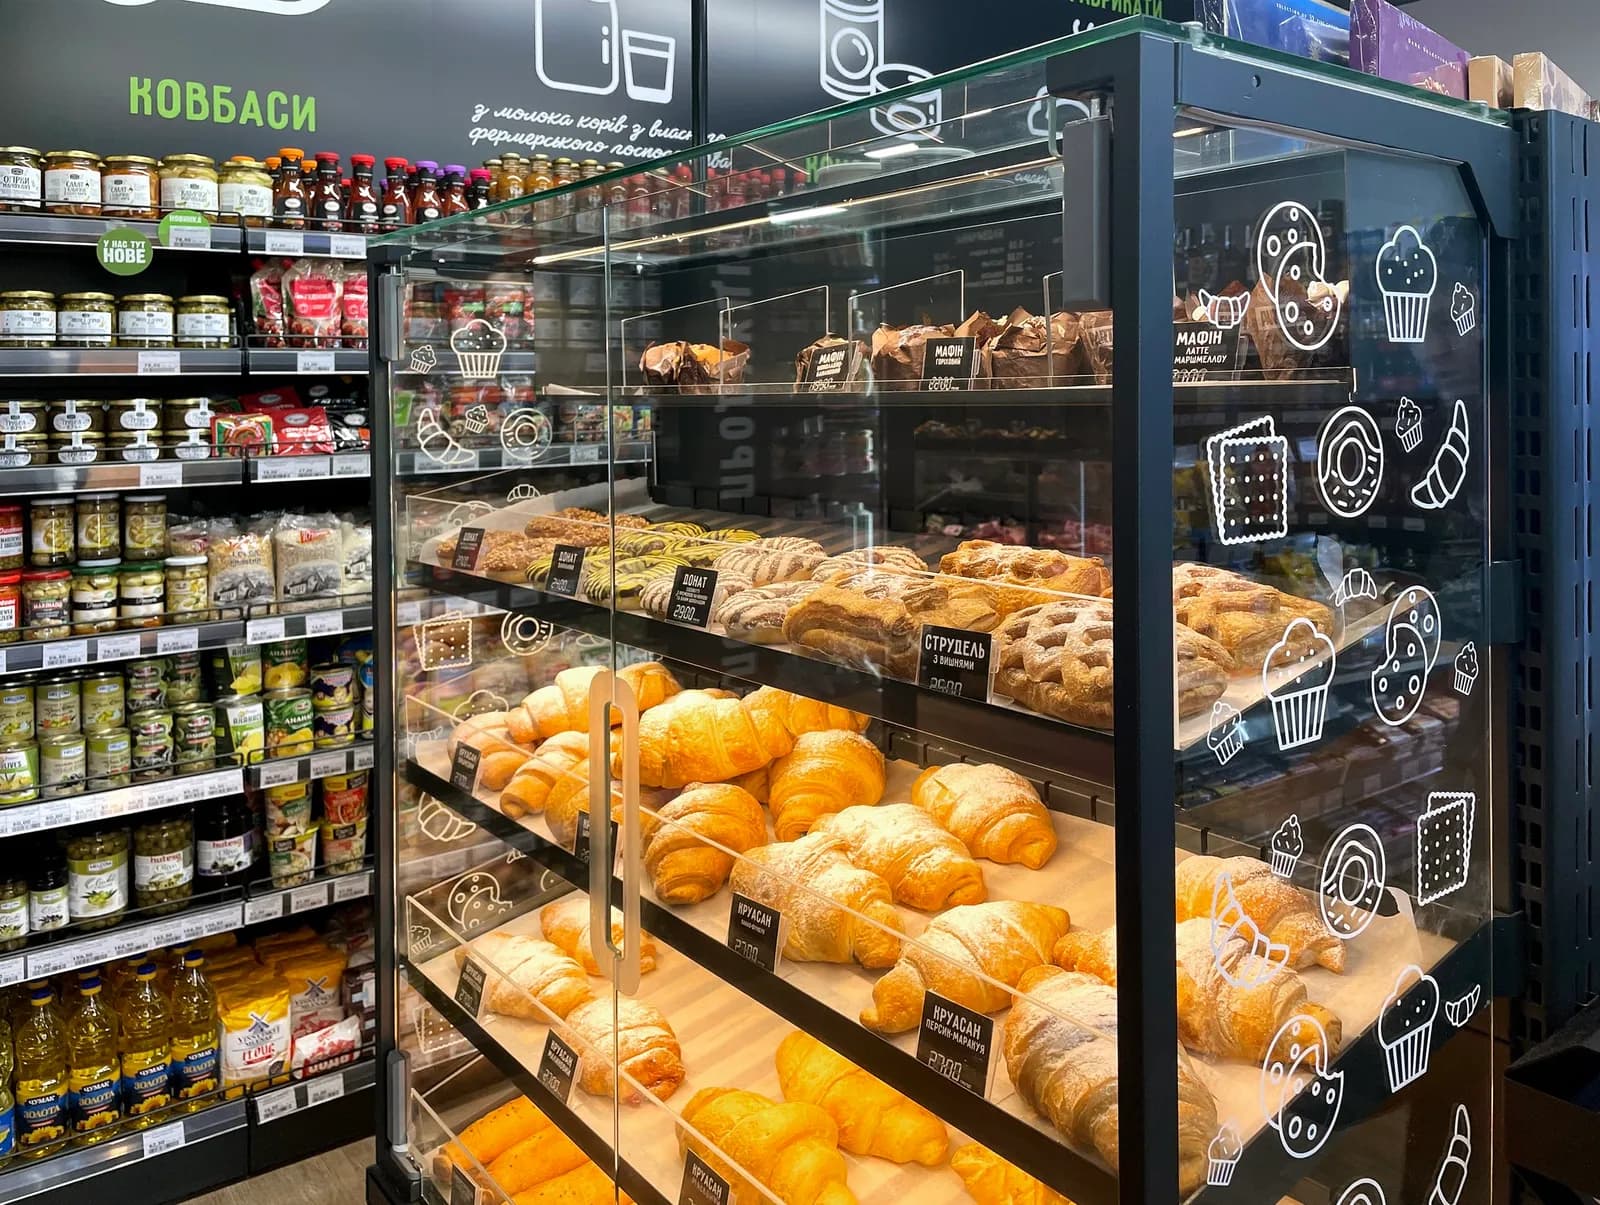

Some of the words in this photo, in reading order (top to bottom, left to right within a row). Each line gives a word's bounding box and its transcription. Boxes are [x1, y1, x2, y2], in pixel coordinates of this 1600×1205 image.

[130, 76, 316, 132] КОВБАСИ
[472, 104, 490, 123] з
[494, 107, 574, 127] молока
[576, 114, 628, 134] корів
[629, 123, 645, 141] з
[468, 127, 608, 151] фермерського
[104, 240, 109, 249] У
[112, 240, 127, 249] НАС
[131, 240, 145, 249] ТУТ
[103, 250, 146, 264] НОВЕ
[1176, 331, 1222, 346] МАФІН
[818, 350, 845, 364] МАФІН
[935, 345, 963, 357] МАФІН
[1186, 346, 1209, 355] ЛАТТЕ
[1174, 355, 1227, 364] МАРШМЕЛЛОУ
[559, 551, 578, 564] ДОНАТ
[682, 573, 708, 589] ДОНАТ
[925, 634, 985, 659] СТРУДЕЛЬ
[932, 655, 938, 664] З
[939, 656, 975, 671] ВИШНЯМИ
[737, 902, 772, 928] КРУАСАН
[933, 1005, 981, 1040] КРУАСАН
[925, 1018, 985, 1055] ПЕРСИК-МАРАКУЯ
[139, 1064, 165, 1076] ЧУМАК
[83, 1080, 111, 1092] ЧУМАК
[28, 1095, 56, 1105] ЧУМАК
[691, 1163, 723, 1199] КРУАСАН
